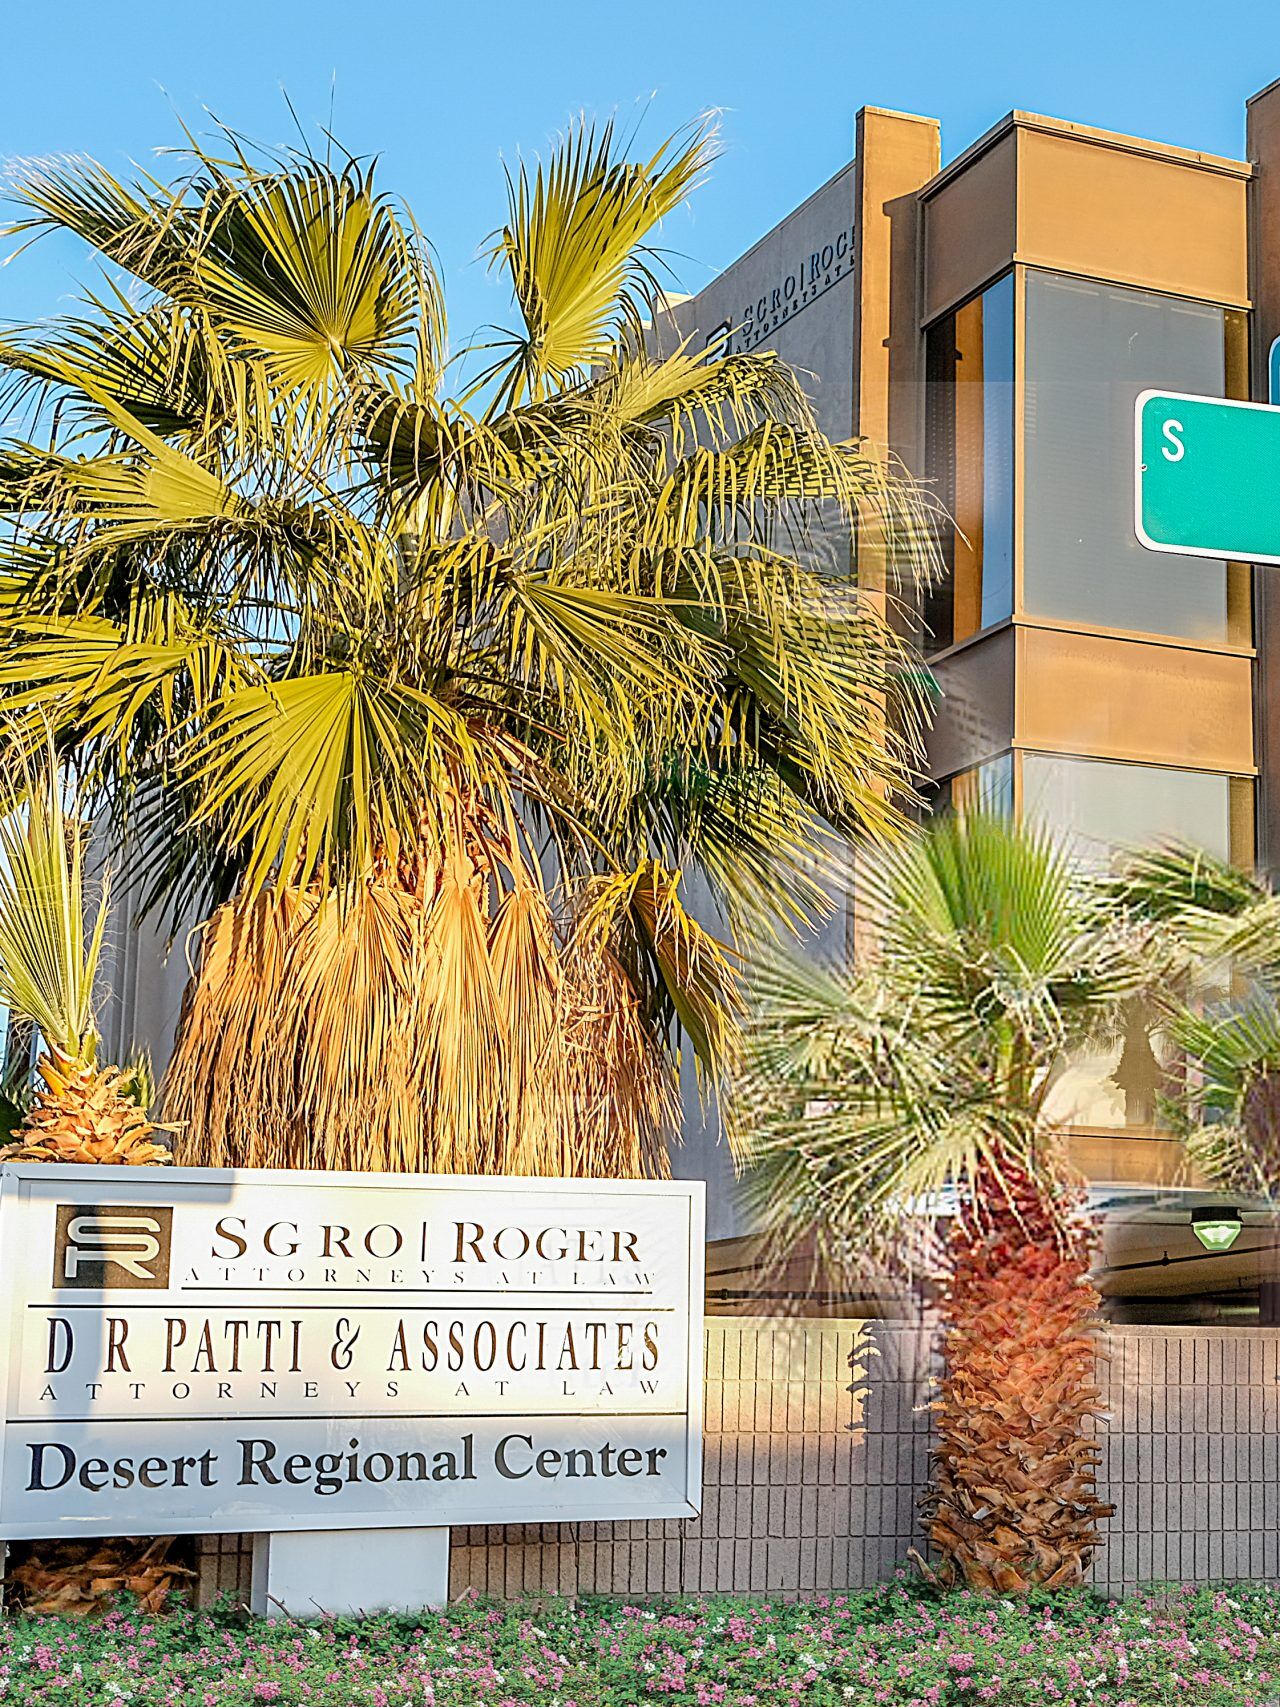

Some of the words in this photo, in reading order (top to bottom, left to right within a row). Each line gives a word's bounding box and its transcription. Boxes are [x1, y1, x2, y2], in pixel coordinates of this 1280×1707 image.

[1161, 419, 1185, 462] S
[450, 1221, 642, 1263] ROGER
[185, 1267, 464, 1284] ATTORNEYS
[497, 1271, 543, 1285] AT
[574, 1272, 656, 1285] LAW
[44, 1317, 74, 1374] D
[104, 1318, 132, 1373] R
[161, 1318, 304, 1373] PATTI
[330, 1317, 361, 1371] &
[386, 1318, 660, 1372] ASSOCIATES
[39, 1381, 399, 1401] ATTORNEYS
[455, 1380, 510, 1397] AT
[563, 1380, 659, 1396] LAW
[25, 1442, 218, 1492] Desert
[236, 1433, 478, 1496] Regional
[495, 1433, 668, 1481] Center
